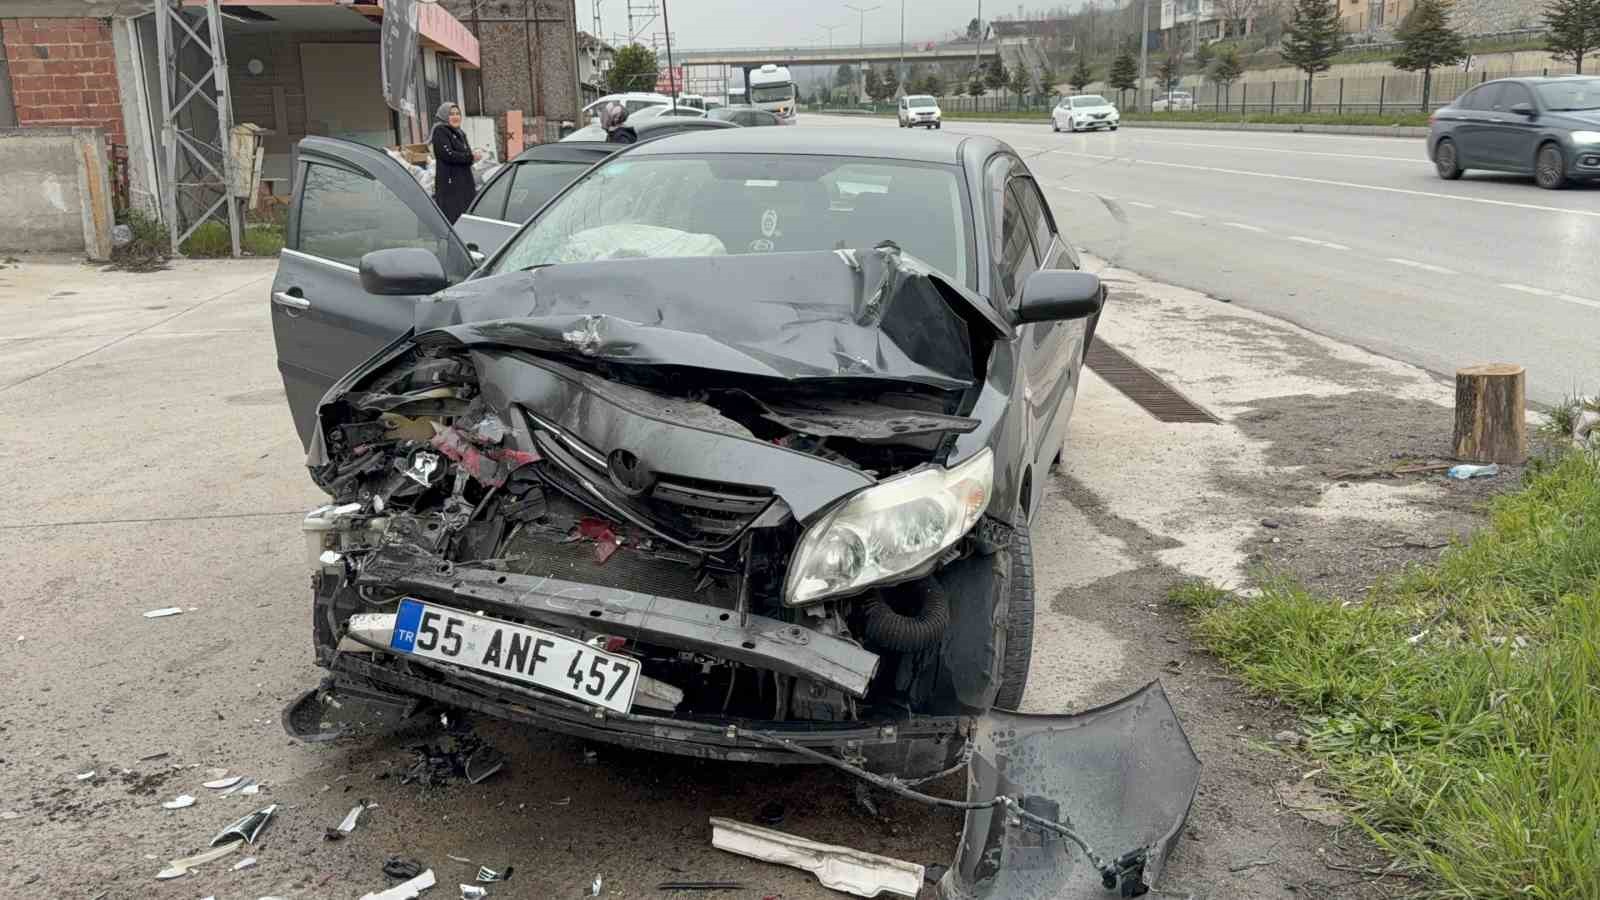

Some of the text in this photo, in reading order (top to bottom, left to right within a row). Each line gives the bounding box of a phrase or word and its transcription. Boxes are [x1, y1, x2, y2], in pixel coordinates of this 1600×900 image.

[398, 628, 415, 642] TR
[417, 611, 631, 702] 55 ANF 457
